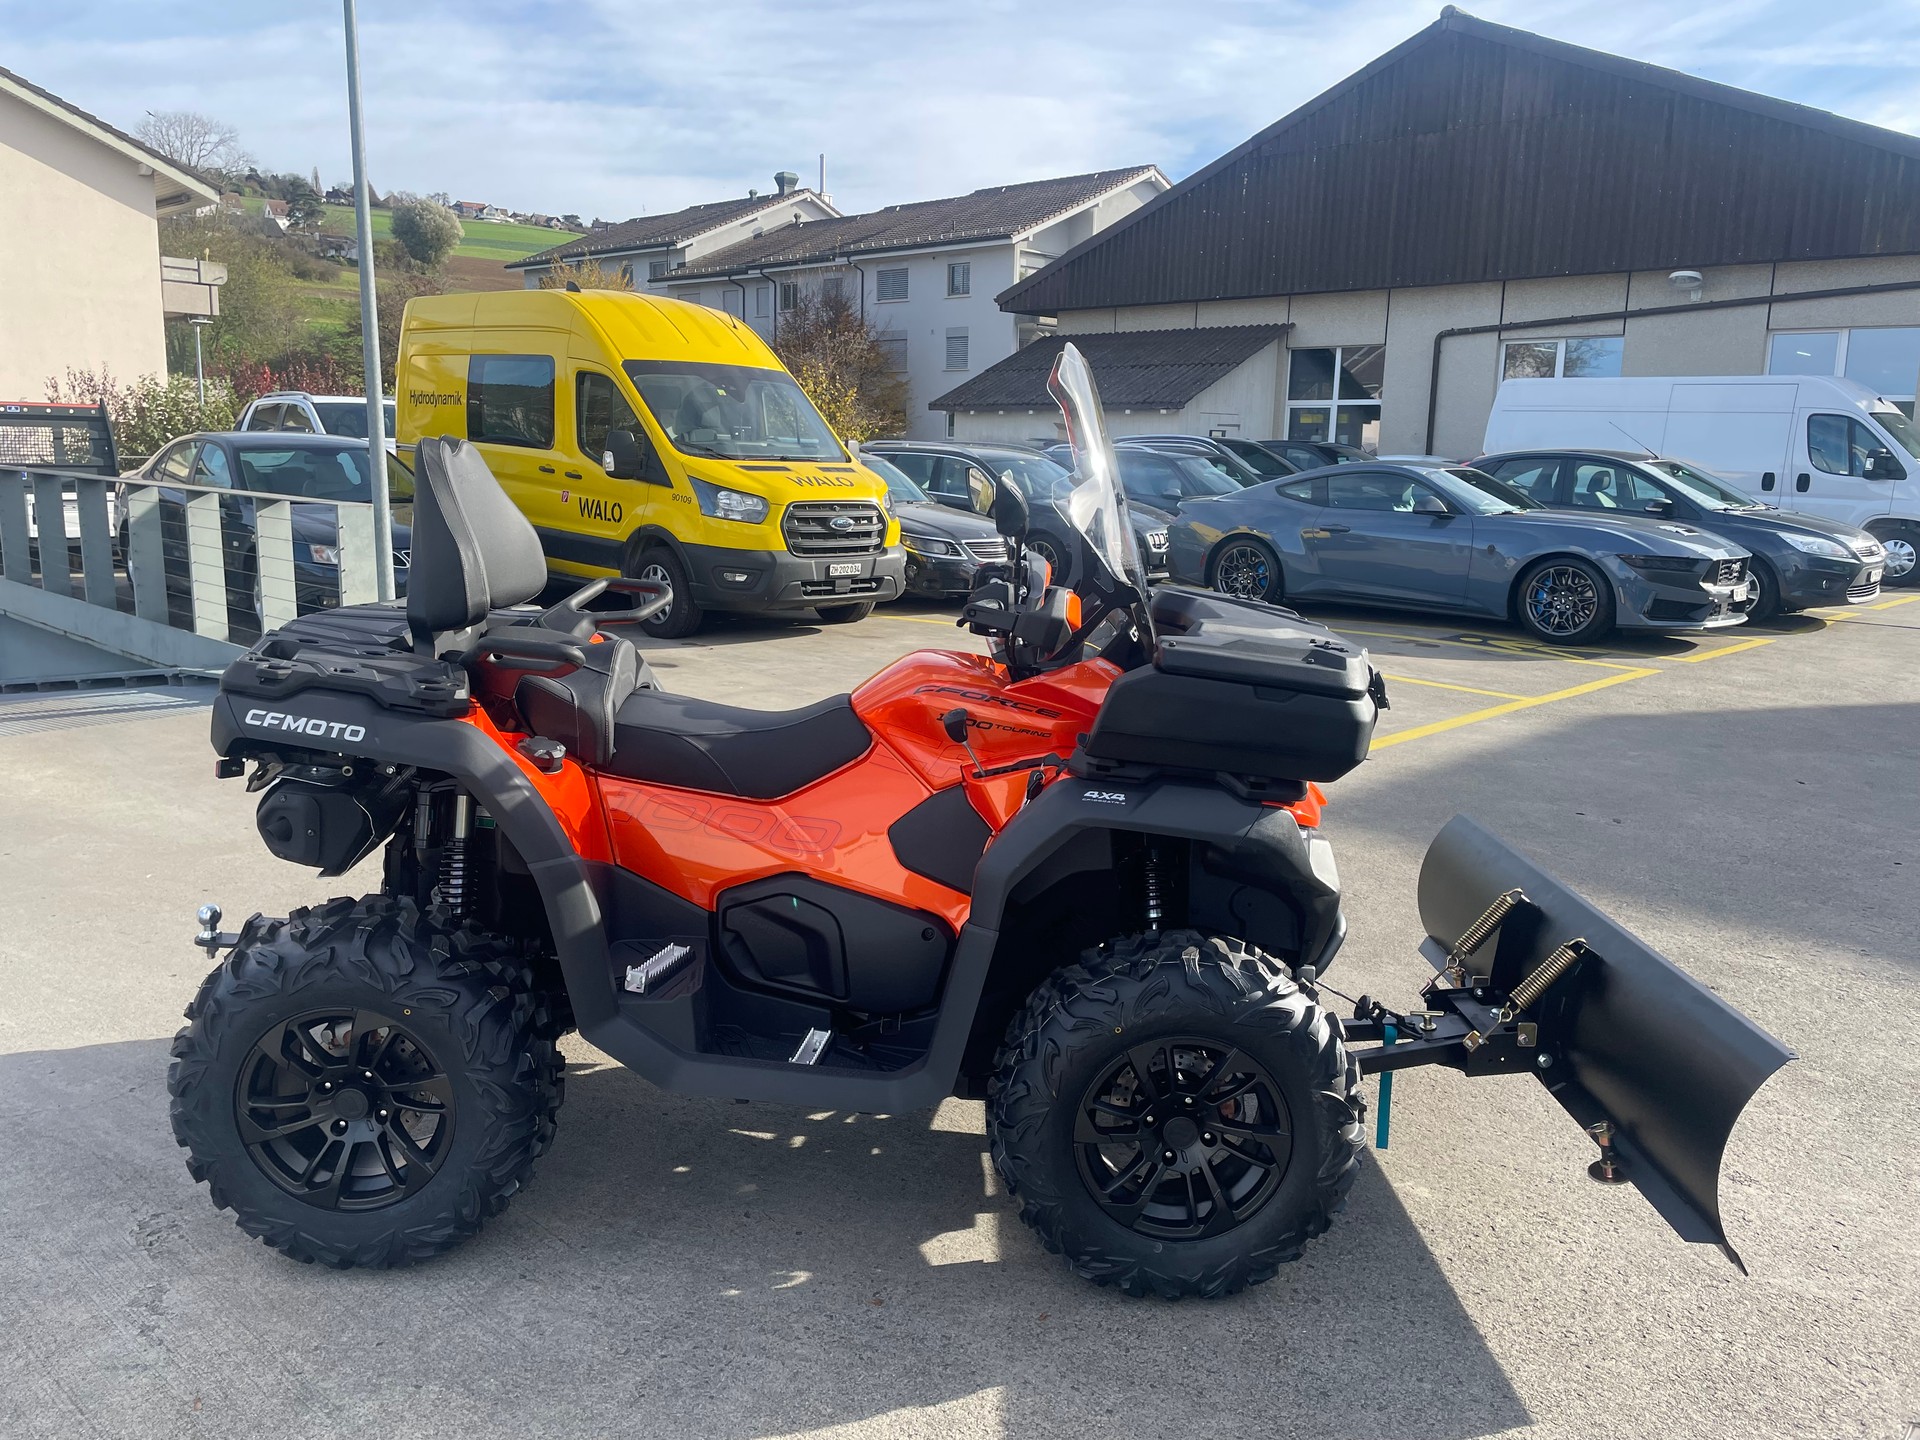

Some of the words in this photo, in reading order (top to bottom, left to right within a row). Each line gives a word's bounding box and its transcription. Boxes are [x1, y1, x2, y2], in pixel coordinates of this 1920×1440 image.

[409, 390, 462, 408] Hydrodynamik
[786, 476, 855, 487] WALO
[578, 497, 623, 523] WALO
[671, 493, 692, 504] 90109
[913, 685, 1062, 719] CFORCE
[244, 708, 366, 742] CFMOTO
[936, 712, 994, 730] 100
[994, 724, 1053, 738] TOURING
